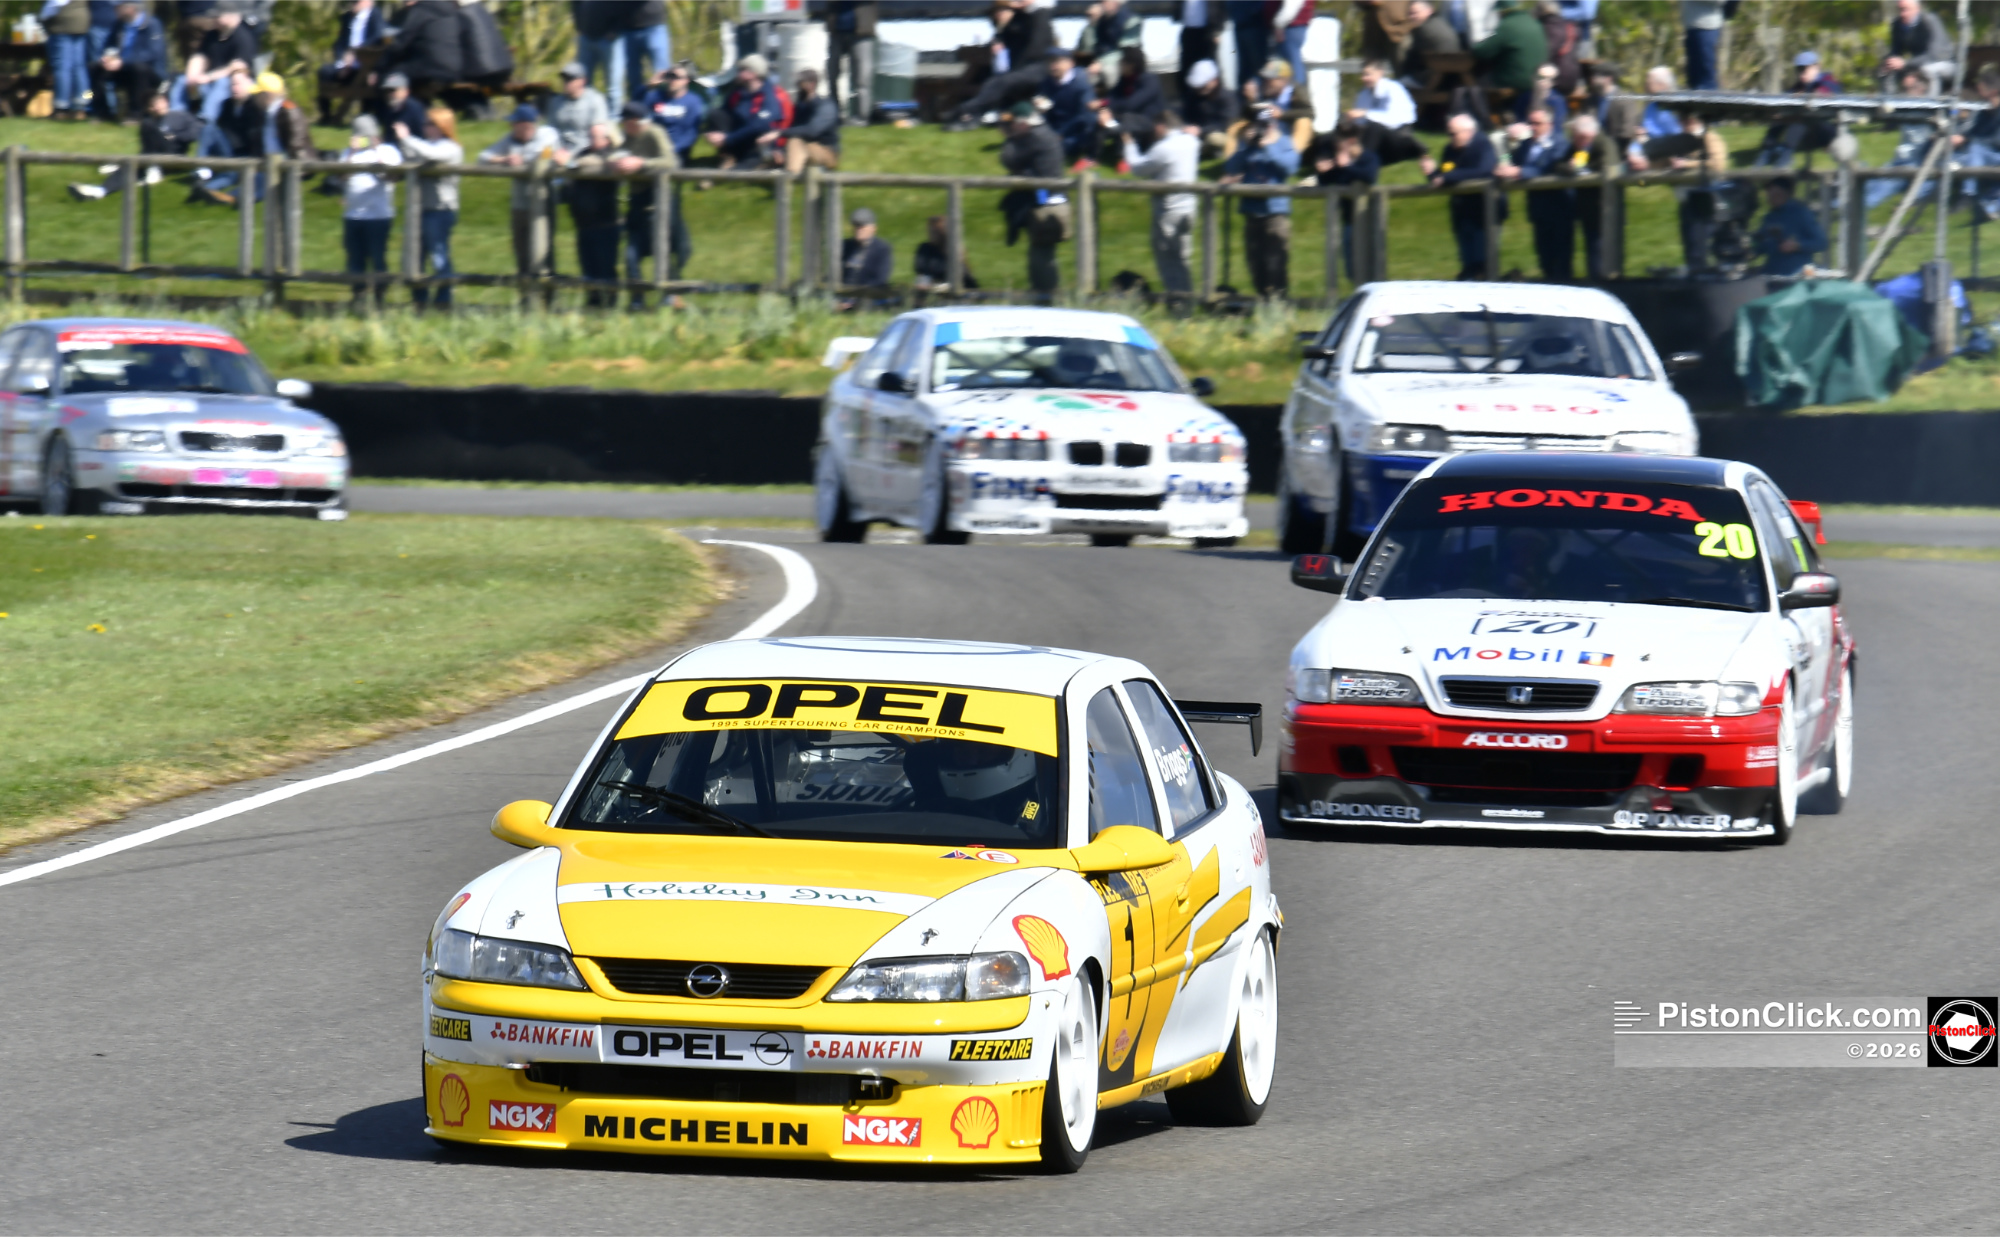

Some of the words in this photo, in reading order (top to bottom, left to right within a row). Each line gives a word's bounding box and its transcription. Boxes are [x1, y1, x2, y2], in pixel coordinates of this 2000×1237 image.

[1455, 403, 1599, 415] ESSO
[1438, 489, 1706, 522] HONDA
[1694, 521, 1756, 559] 20
[1488, 620, 1580, 634] 20
[1433, 647, 1564, 662] Mobil
[1338, 688, 1411, 698] Trader
[1353, 678, 1400, 688] Auto
[683, 683, 1005, 734] OPEL
[711, 720, 739, 728] 1995
[744, 719, 848, 728] SUPERTOURING
[853, 722, 881, 730] CAR
[886, 723, 966, 737] CHAMPIONS
[1462, 731, 1569, 749] ACCORD
[1153, 745, 1188, 787] Briggs
[1326, 802, 1421, 821] PIONEER
[1632, 812, 1732, 830] PIONEER
[594, 882, 766, 900] Holiday
[789, 888, 886, 904] Inn
[507, 1023, 594, 1048] BANKFIN
[613, 1030, 744, 1062] OPEL
[828, 1040, 923, 1059] BANKFIN
[950, 1038, 1033, 1060] FLEETCARE
[489, 1103, 545, 1130] NGK
[584, 1115, 808, 1146] MICHELIN
[844, 1118, 908, 1146] NGK
